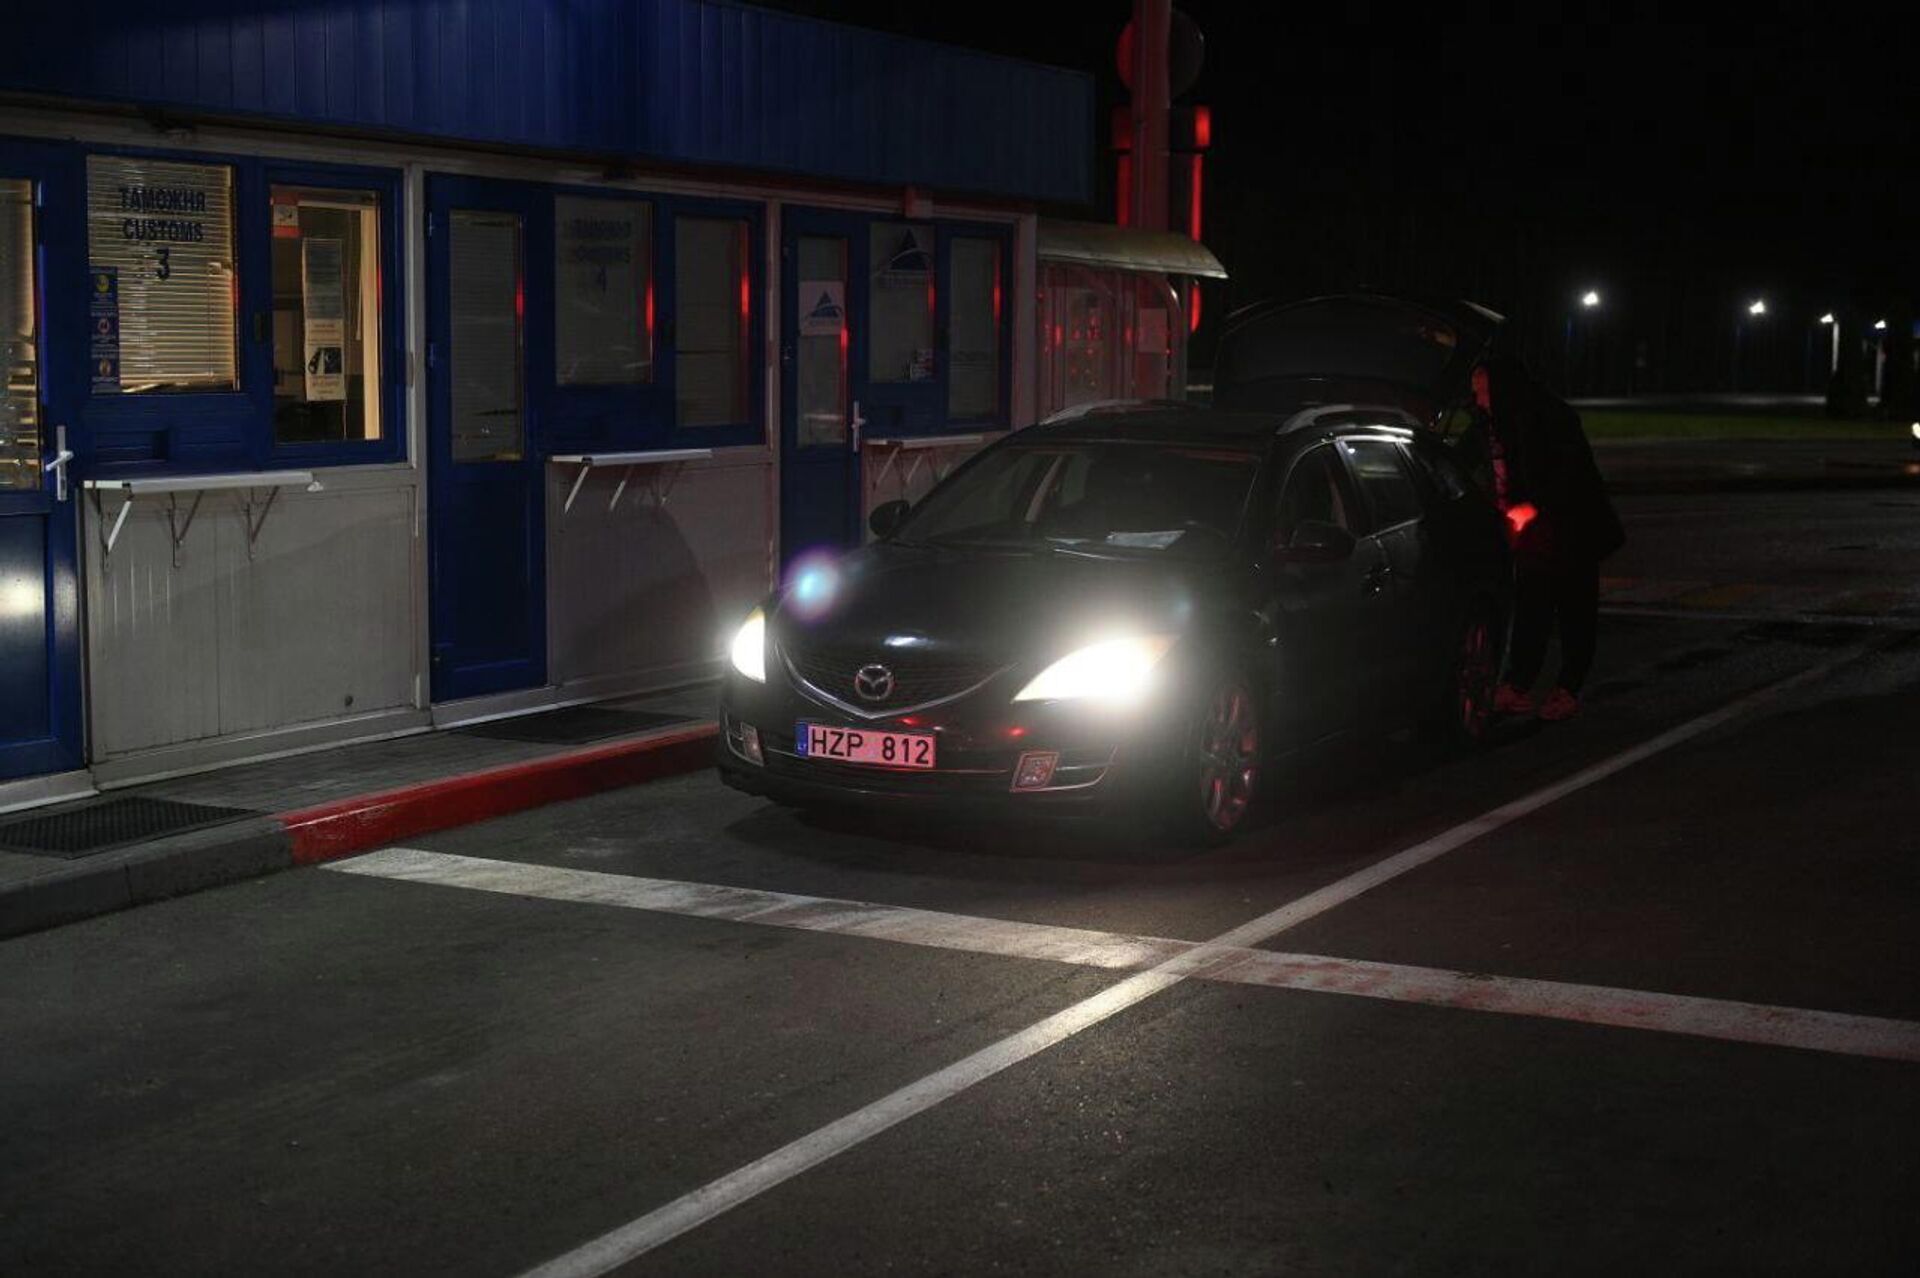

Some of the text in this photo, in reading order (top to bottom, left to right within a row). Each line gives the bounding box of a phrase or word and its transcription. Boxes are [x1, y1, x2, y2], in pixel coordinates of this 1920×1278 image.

[119, 188, 205, 212] ТАМОЖНЯ
[124, 219, 203, 242] CUSTOMS
[156, 248, 170, 278] 3
[811, 729, 863, 757] HZP
[881, 736, 928, 764] 812
